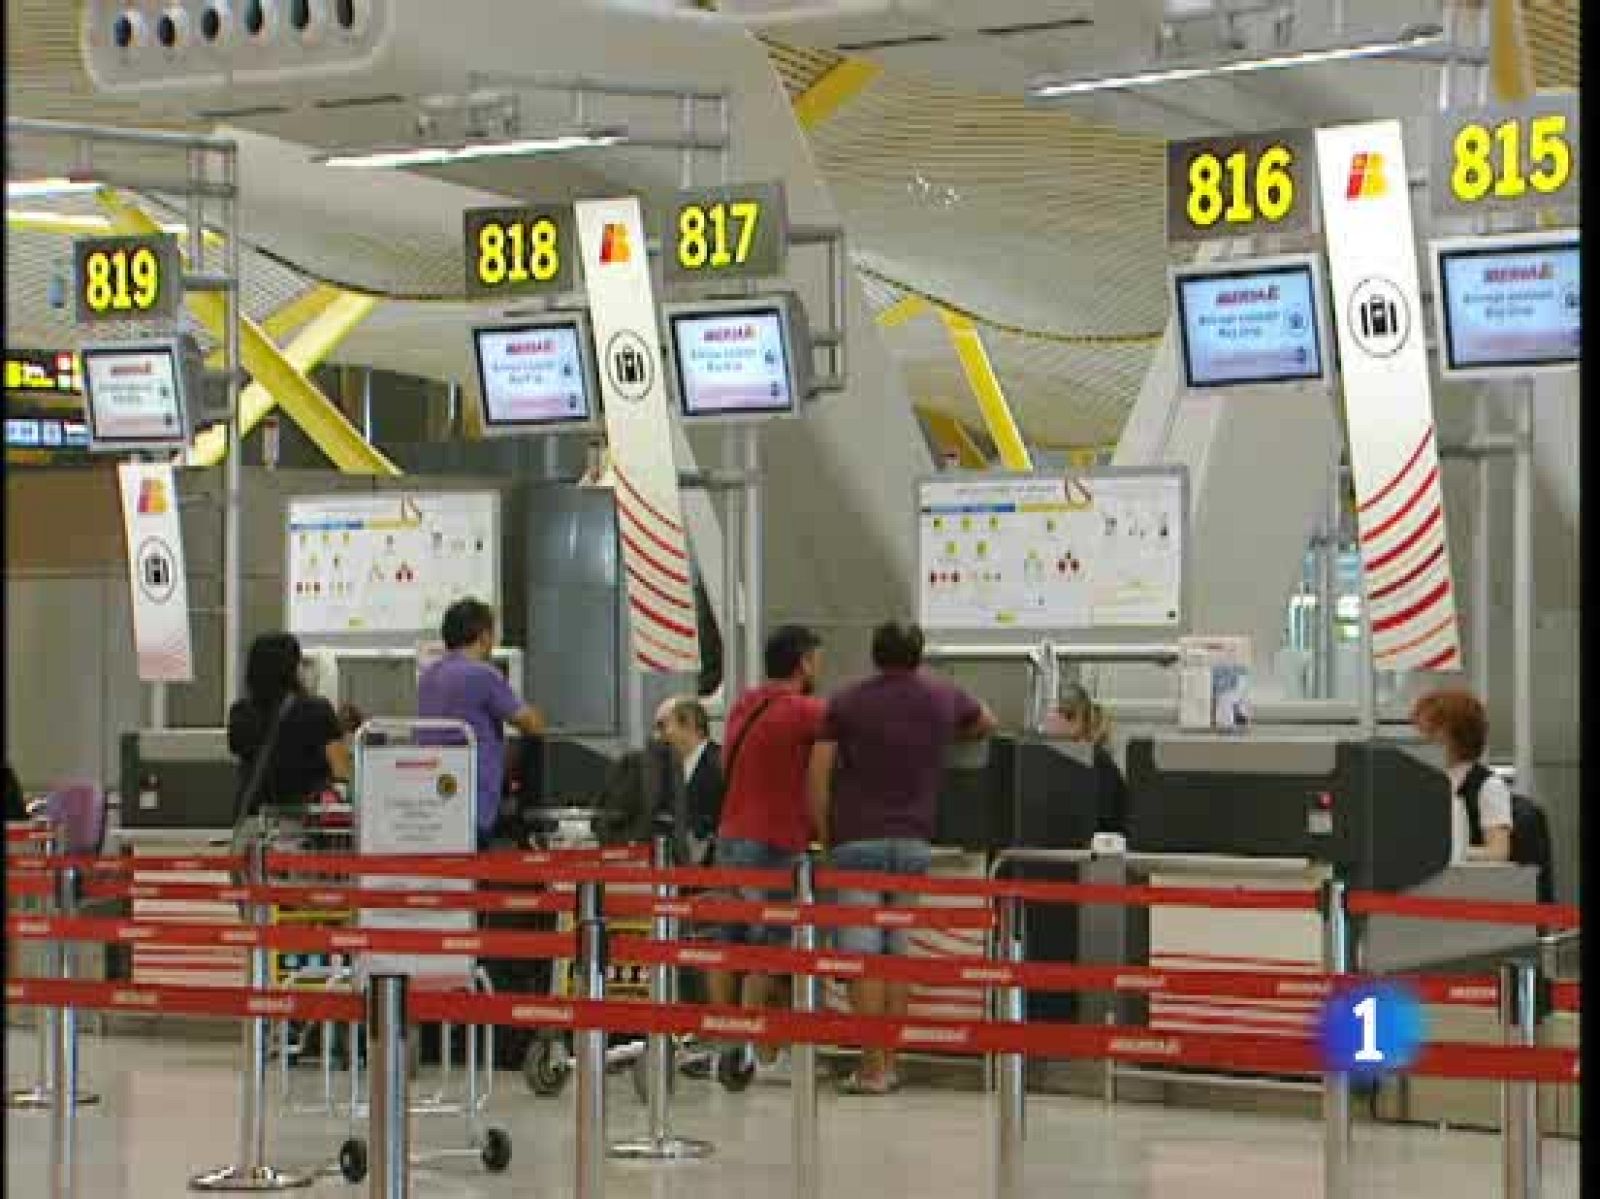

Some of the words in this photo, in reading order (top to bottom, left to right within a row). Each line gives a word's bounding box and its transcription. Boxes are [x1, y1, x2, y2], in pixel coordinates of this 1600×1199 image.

[1186, 146, 1294, 225] 816
[1450, 114, 1571, 201] 815
[478, 219, 560, 283] 818
[677, 202, 759, 269] 817
[87, 248, 160, 311] 819
